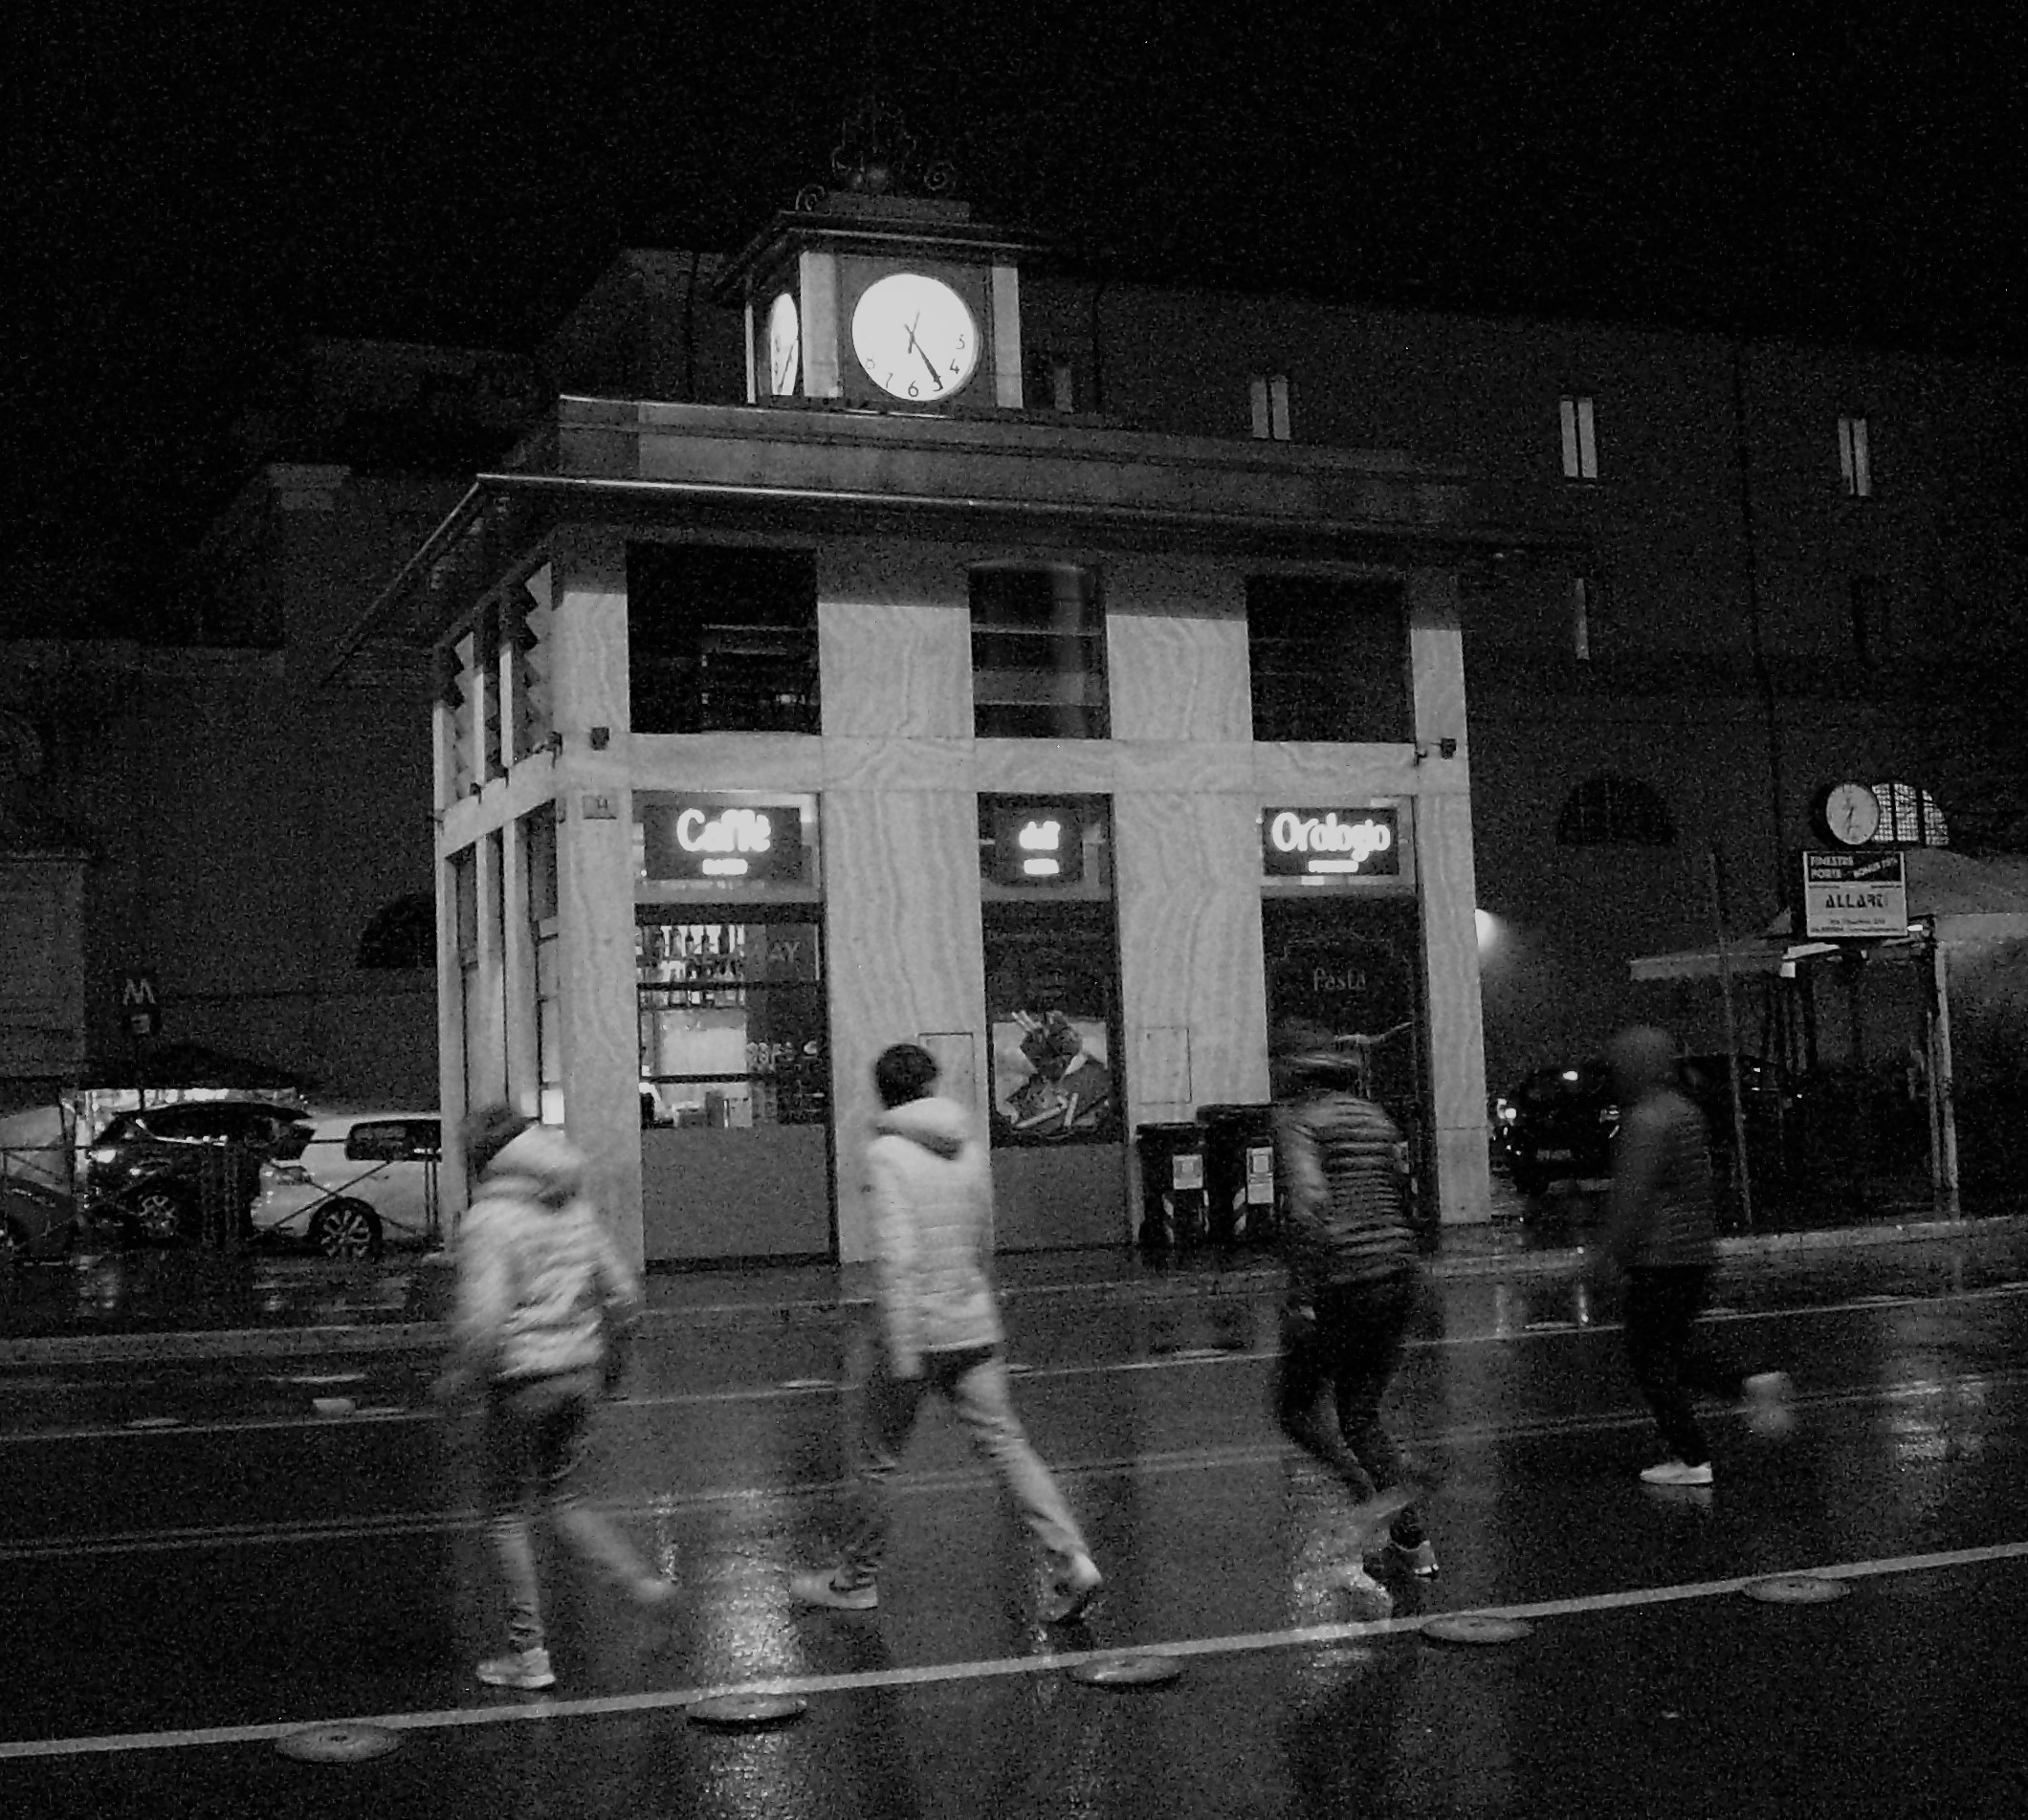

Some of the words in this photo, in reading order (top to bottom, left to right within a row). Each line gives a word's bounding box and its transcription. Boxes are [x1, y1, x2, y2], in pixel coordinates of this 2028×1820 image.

[949, 358, 960, 375] 4
[885, 373, 893, 389] 7
[908, 380, 919, 398] 6
[121, 977, 157, 1007] M
